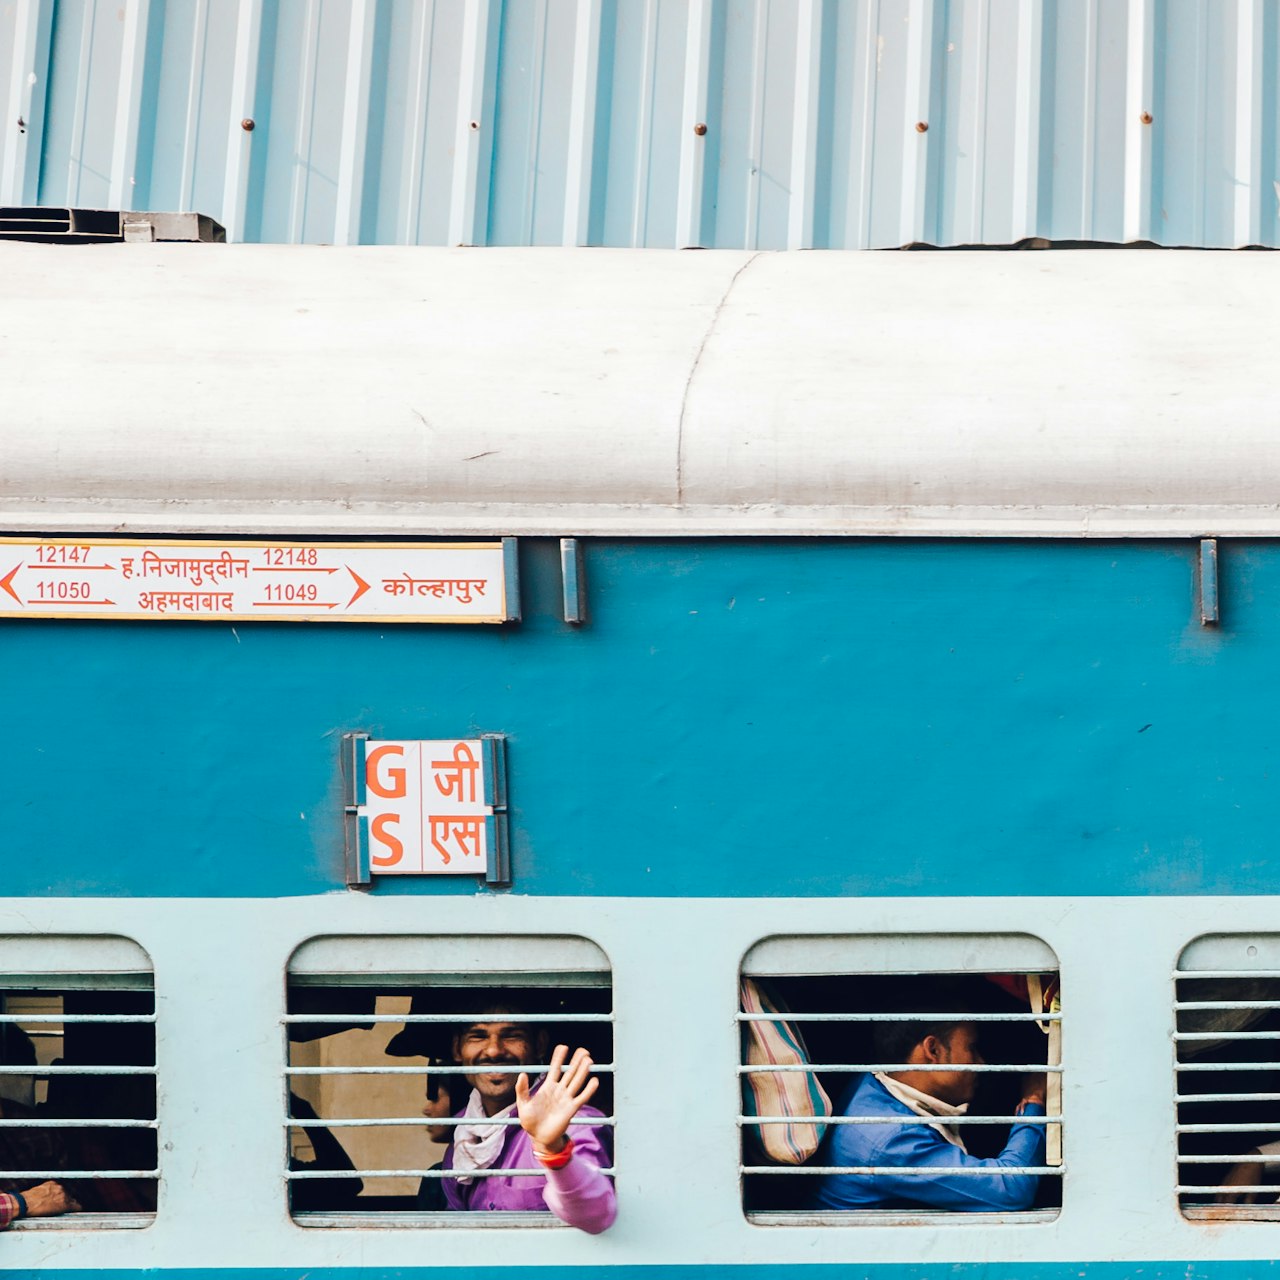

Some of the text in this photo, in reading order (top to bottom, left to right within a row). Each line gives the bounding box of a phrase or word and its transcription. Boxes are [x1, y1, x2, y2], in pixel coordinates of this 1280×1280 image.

[36, 546, 91, 564] 12147
[263, 548, 318, 566] 12148
[36, 582, 91, 599] 11050
[264, 584, 317, 601] 11049
[381, 572, 488, 604] कोल्हापुर
[138, 591, 234, 613] अहमदाबाद
[366, 745, 407, 799] G
[431, 742, 480, 802] जी
[371, 812, 404, 867] S
[428, 815, 485, 865] एस
